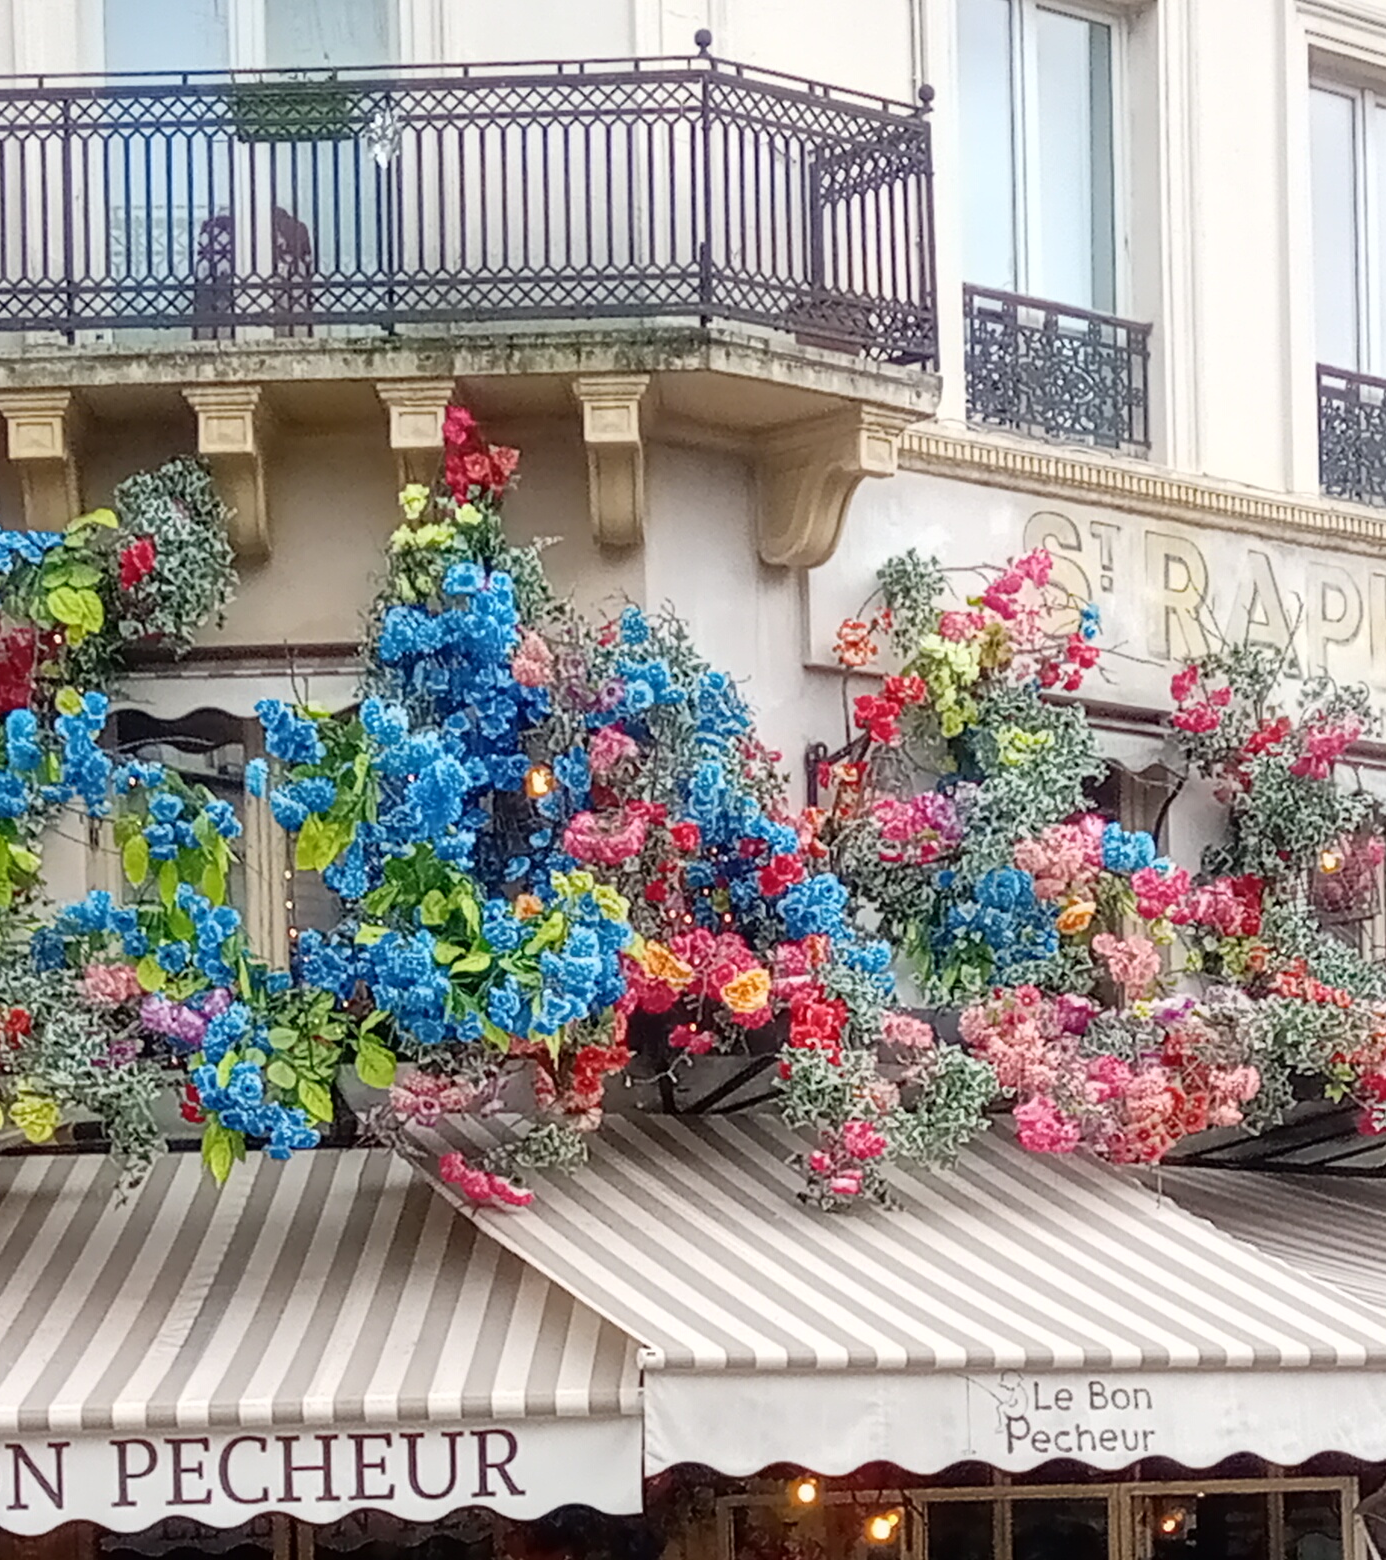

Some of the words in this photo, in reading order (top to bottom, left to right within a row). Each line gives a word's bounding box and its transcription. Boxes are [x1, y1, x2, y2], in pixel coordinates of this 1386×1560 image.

[1033, 1380, 1074, 1411] Le
[1088, 1380, 1153, 1411] Bon
[1005, 1415, 1156, 1455] Pecheur
[109, 1428, 527, 1508] PECHEUR
